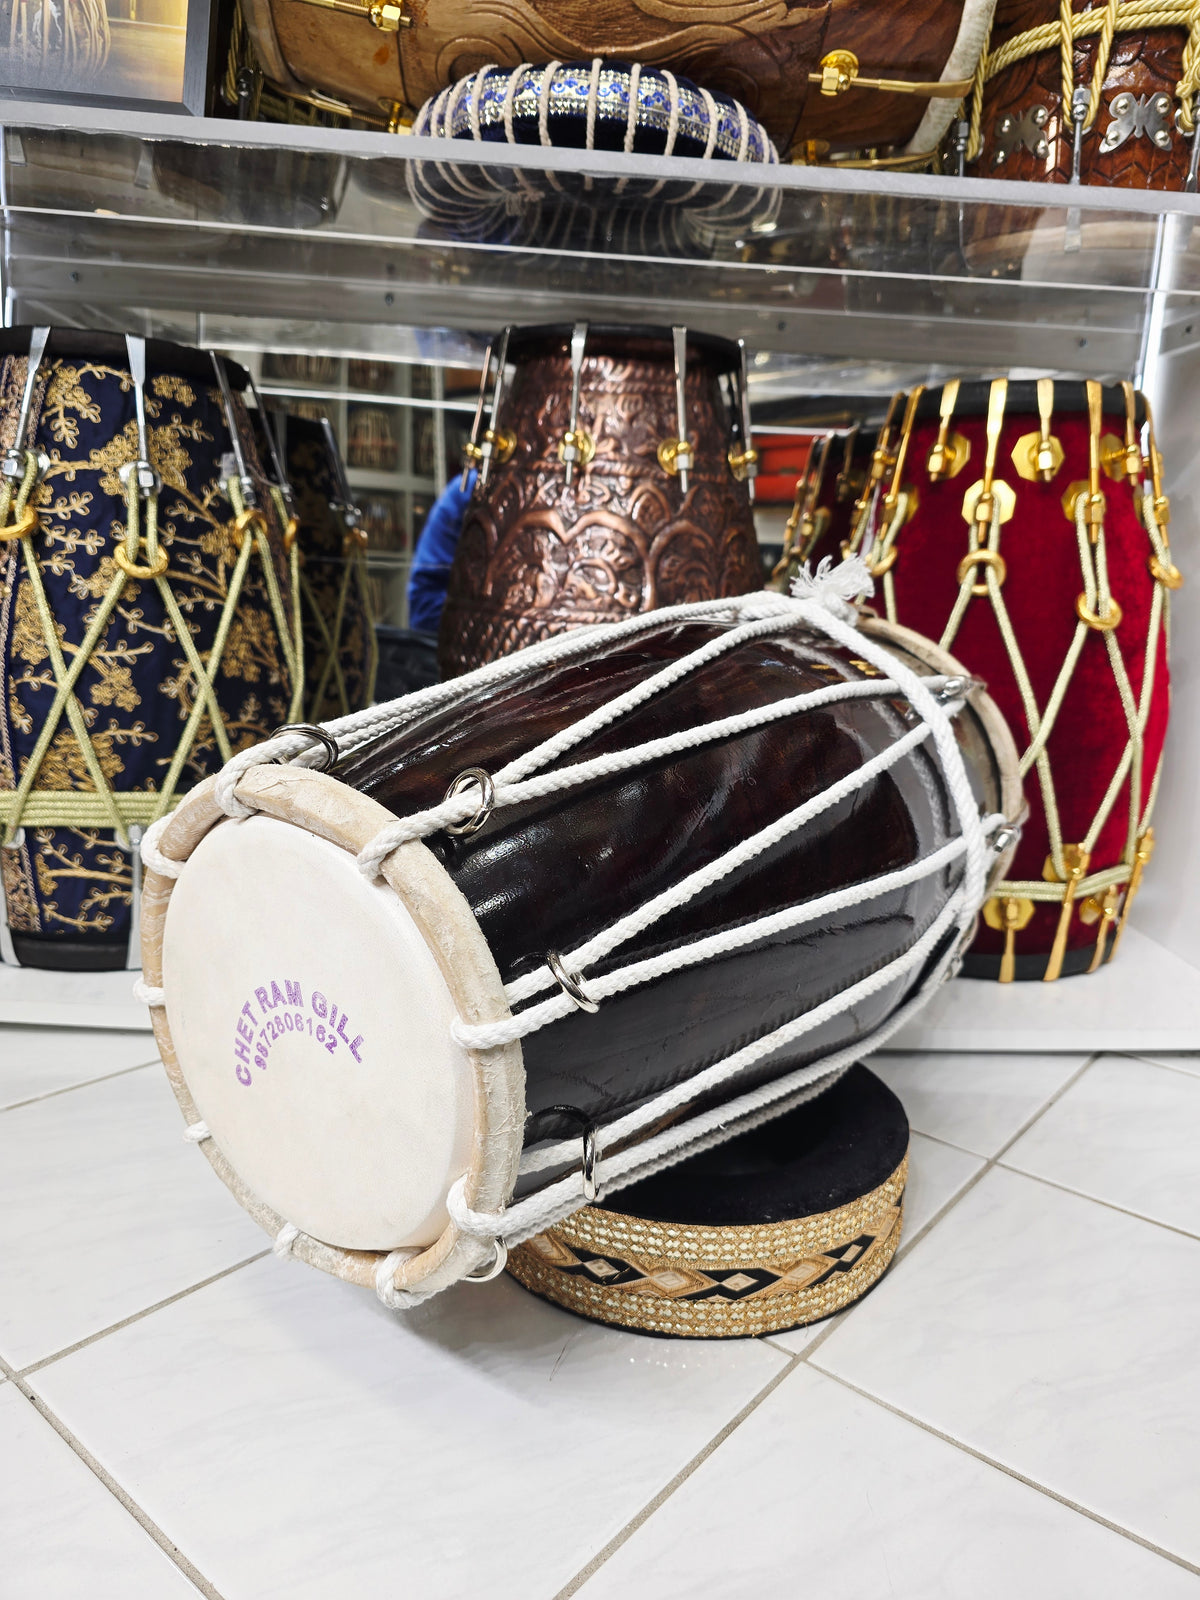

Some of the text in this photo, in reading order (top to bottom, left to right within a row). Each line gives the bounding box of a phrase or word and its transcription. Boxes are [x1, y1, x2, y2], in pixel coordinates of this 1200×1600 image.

[235, 979, 364, 1086] CHET RAM GILL
